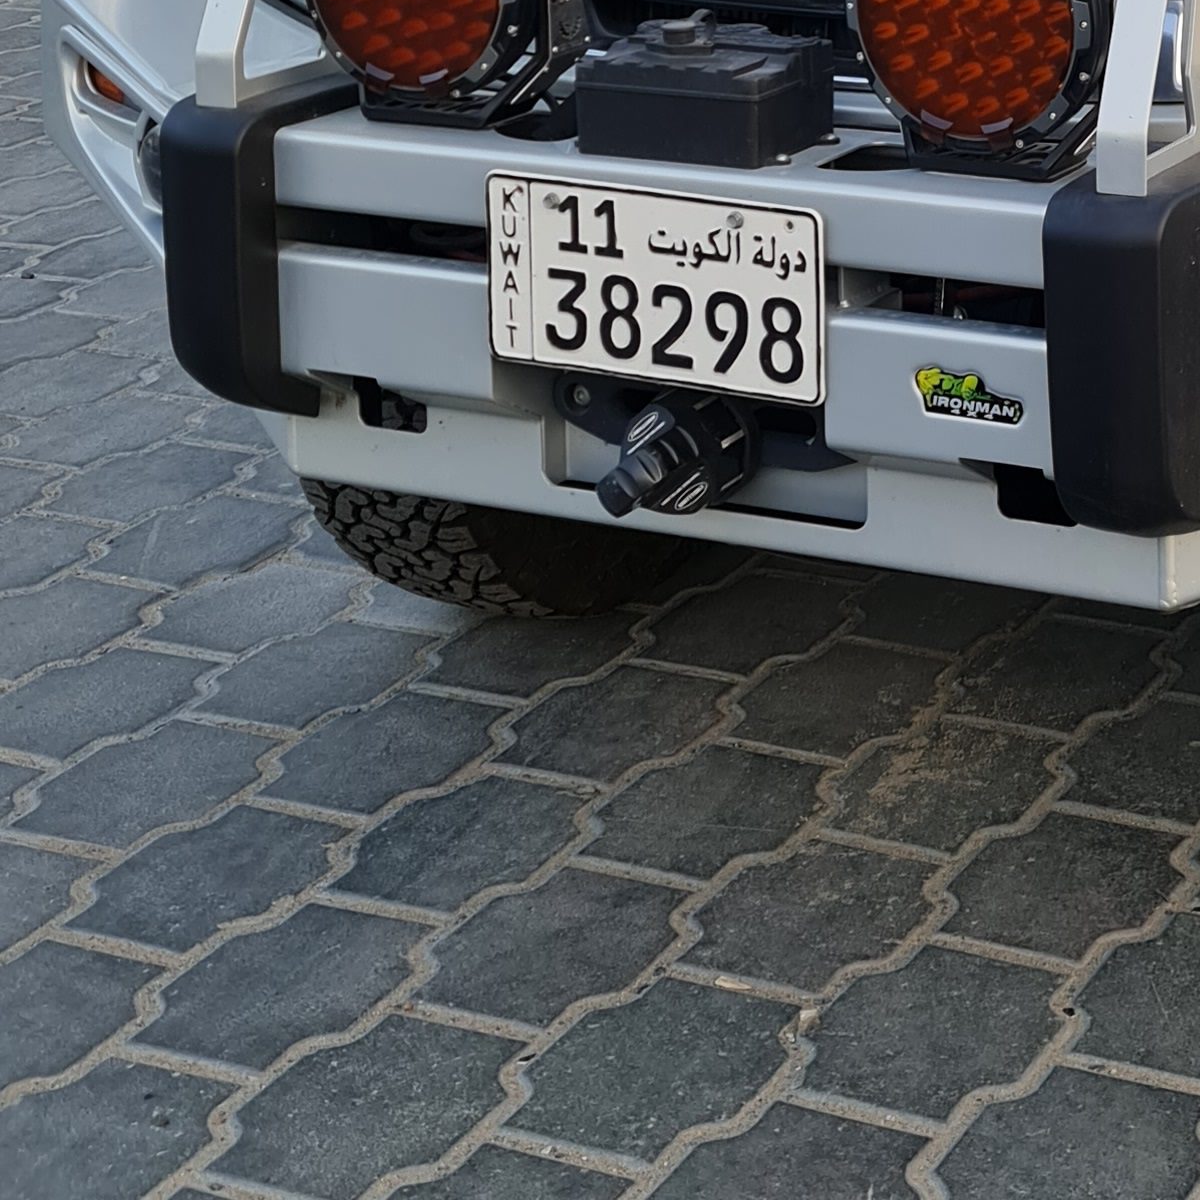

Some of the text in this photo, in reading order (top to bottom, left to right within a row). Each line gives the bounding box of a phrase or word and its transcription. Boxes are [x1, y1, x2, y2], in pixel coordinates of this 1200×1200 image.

[557, 195, 624, 260] 11
[647, 227, 808, 281] دولة الكويت
[499, 185, 525, 349] KUWAIT
[545, 267, 805, 384] 38298
[932, 395, 1016, 418] IRONMAN
